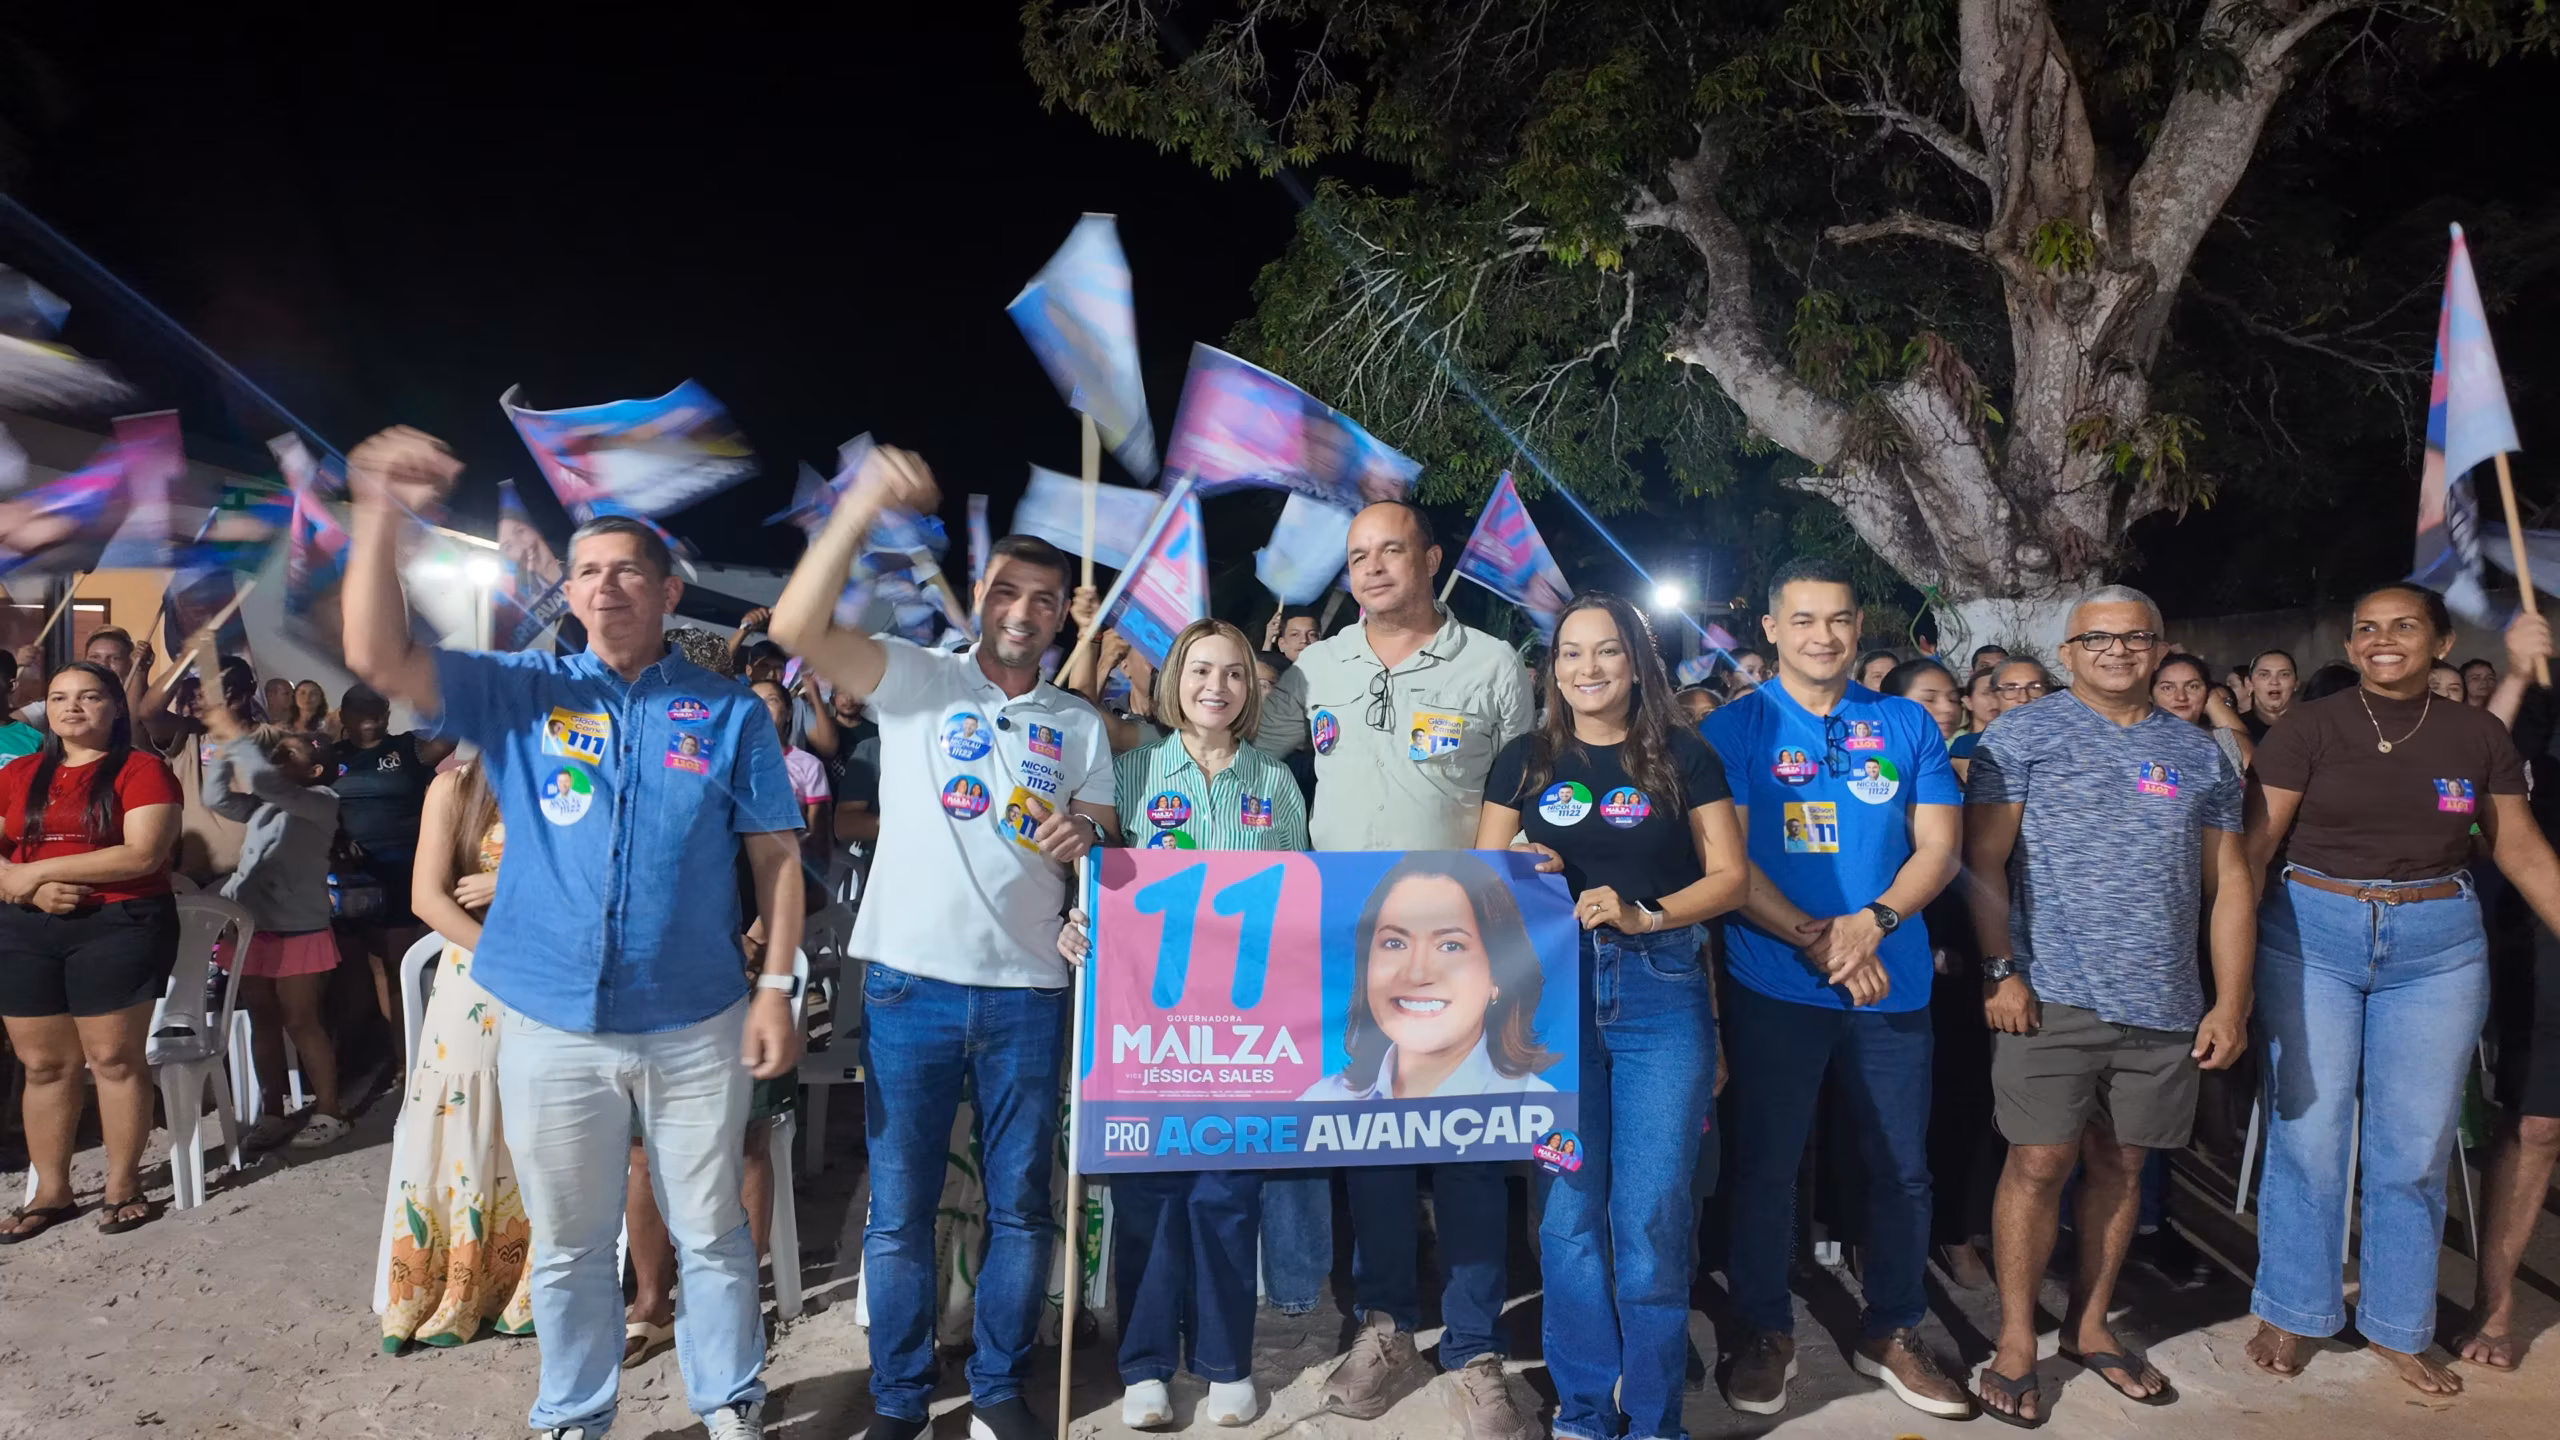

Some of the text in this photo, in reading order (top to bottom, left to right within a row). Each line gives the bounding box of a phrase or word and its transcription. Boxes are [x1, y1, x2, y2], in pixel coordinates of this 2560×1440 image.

[1428, 717, 1461, 728] Gladson
[568, 729, 605, 755] 111
[1021, 760, 1065, 781] NICOLAU
[1027, 776, 1057, 794] 11122
[1133, 861, 1285, 1011] 11
[1166, 1014, 1242, 1023] GOVERNADORA
[1112, 1024, 1304, 1065] MAILZA
[1142, 1067, 1215, 1086] JÉSSICA
[1218, 1069, 1274, 1083] SALES
[1104, 1104, 1555, 1156] PRO ACRE AVANÇAR
